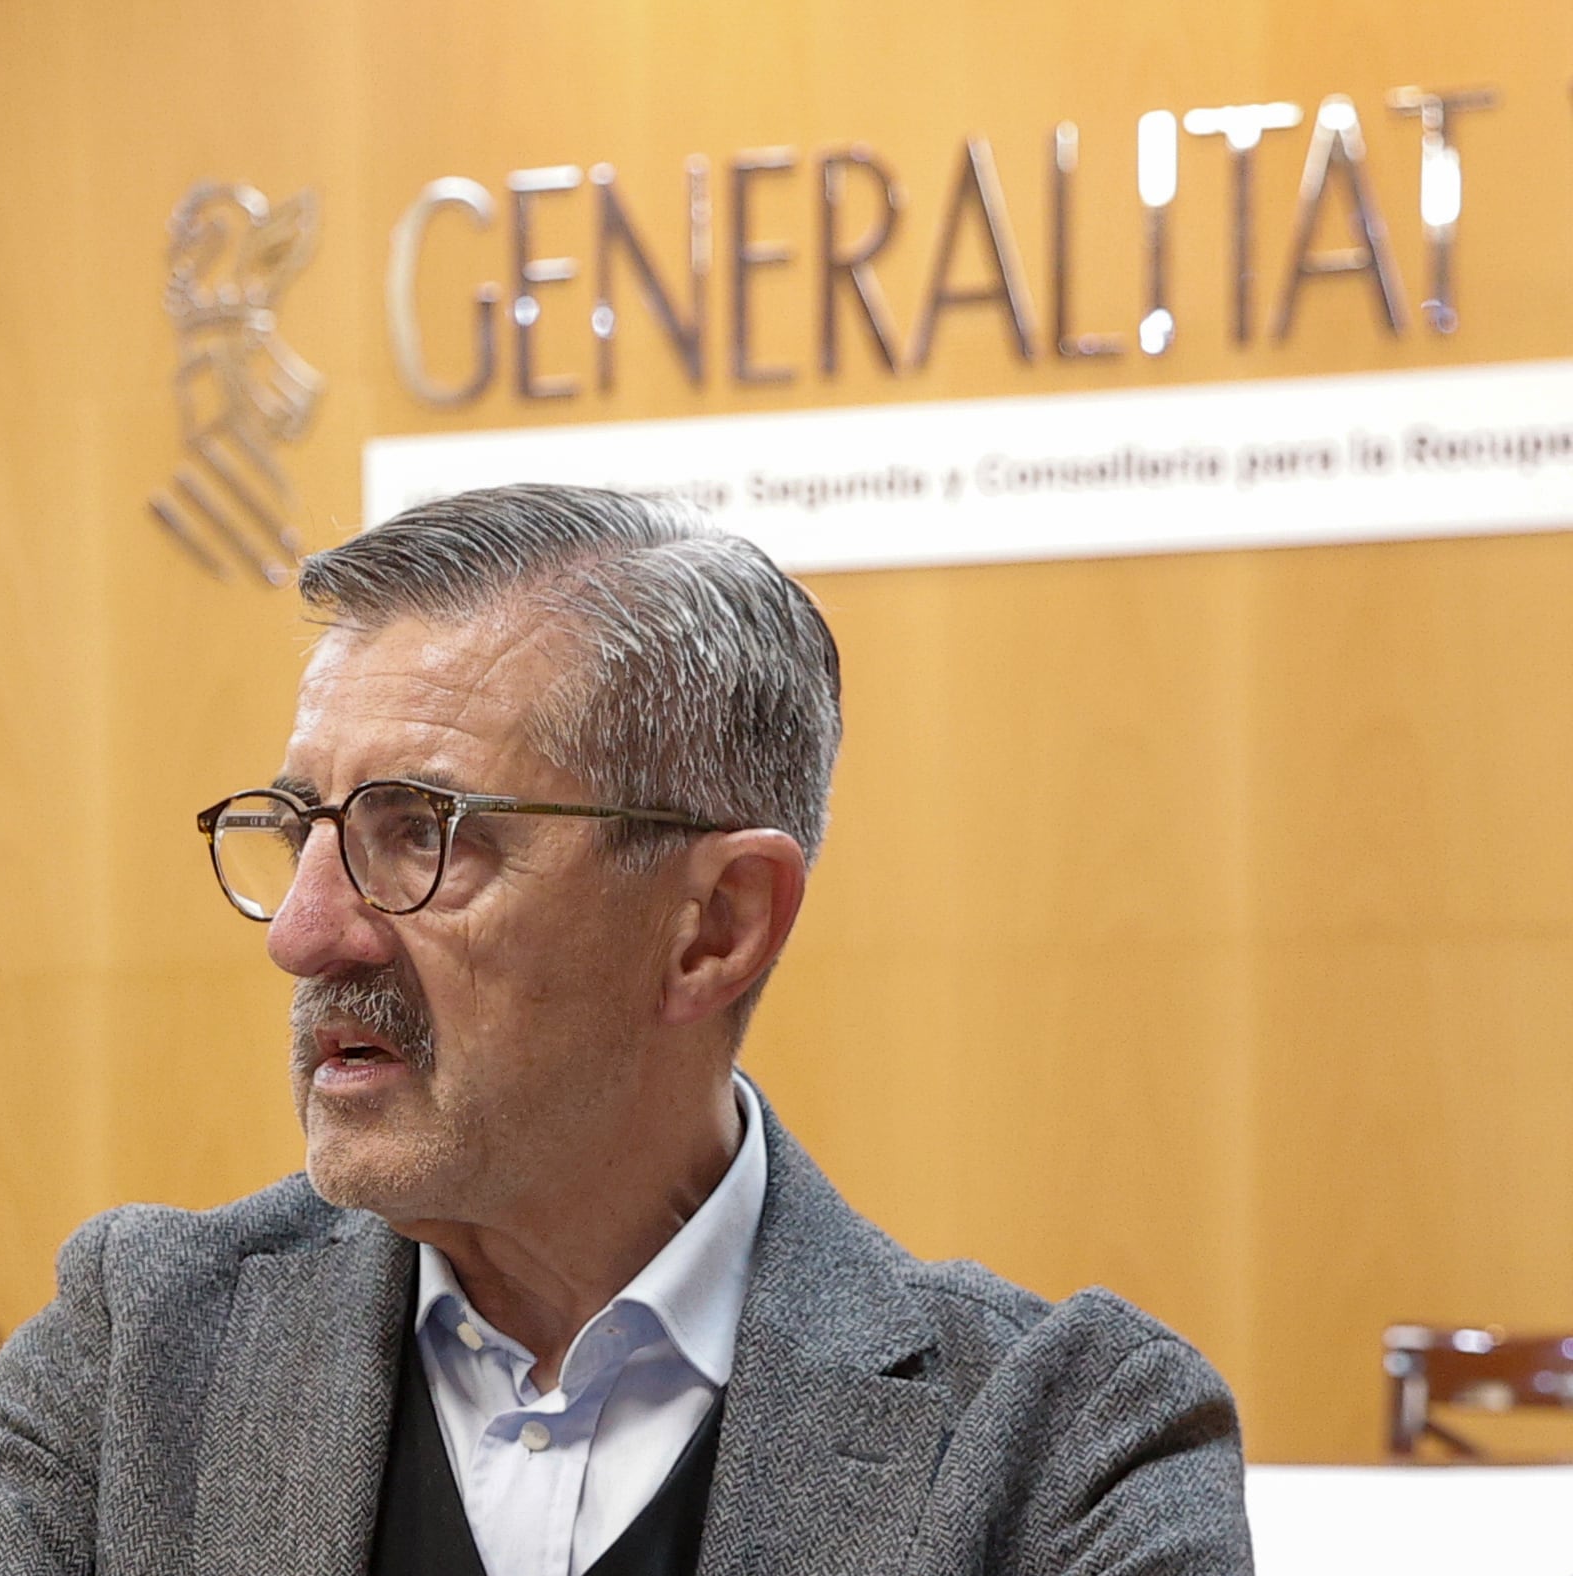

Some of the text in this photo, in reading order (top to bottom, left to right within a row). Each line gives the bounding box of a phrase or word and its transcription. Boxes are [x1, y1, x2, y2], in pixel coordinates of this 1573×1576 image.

[385, 86, 1503, 408] GENERALITAT
[750, 464, 928, 510] Segunda
[1236, 444, 1341, 491] para
[1349, 428, 1396, 476] la
